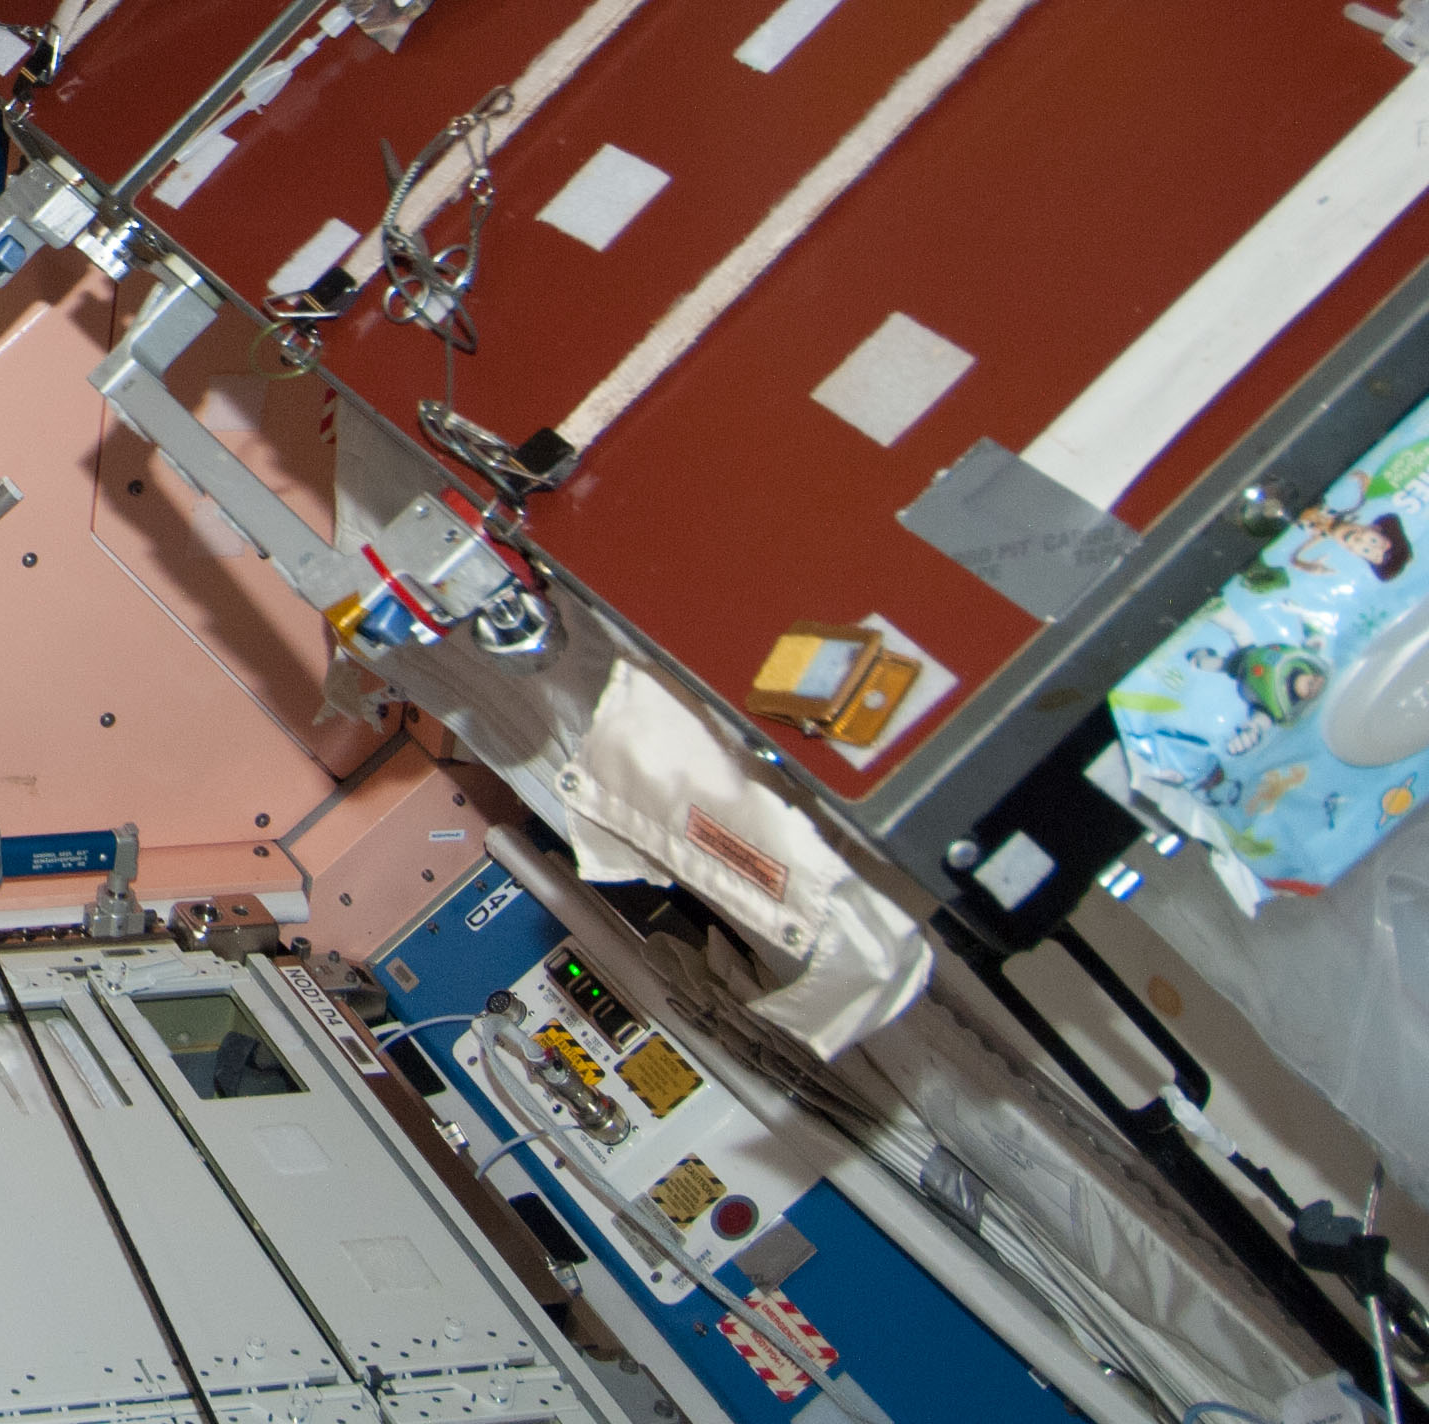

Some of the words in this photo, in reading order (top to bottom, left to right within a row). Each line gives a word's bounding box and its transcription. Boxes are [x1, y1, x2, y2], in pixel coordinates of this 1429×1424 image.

[286, 968, 327, 1005] NOD1
[321, 1008, 344, 1027] D4
[684, 1162, 713, 1196] CAUTION
[761, 1303, 802, 1347] EMERGENCY
